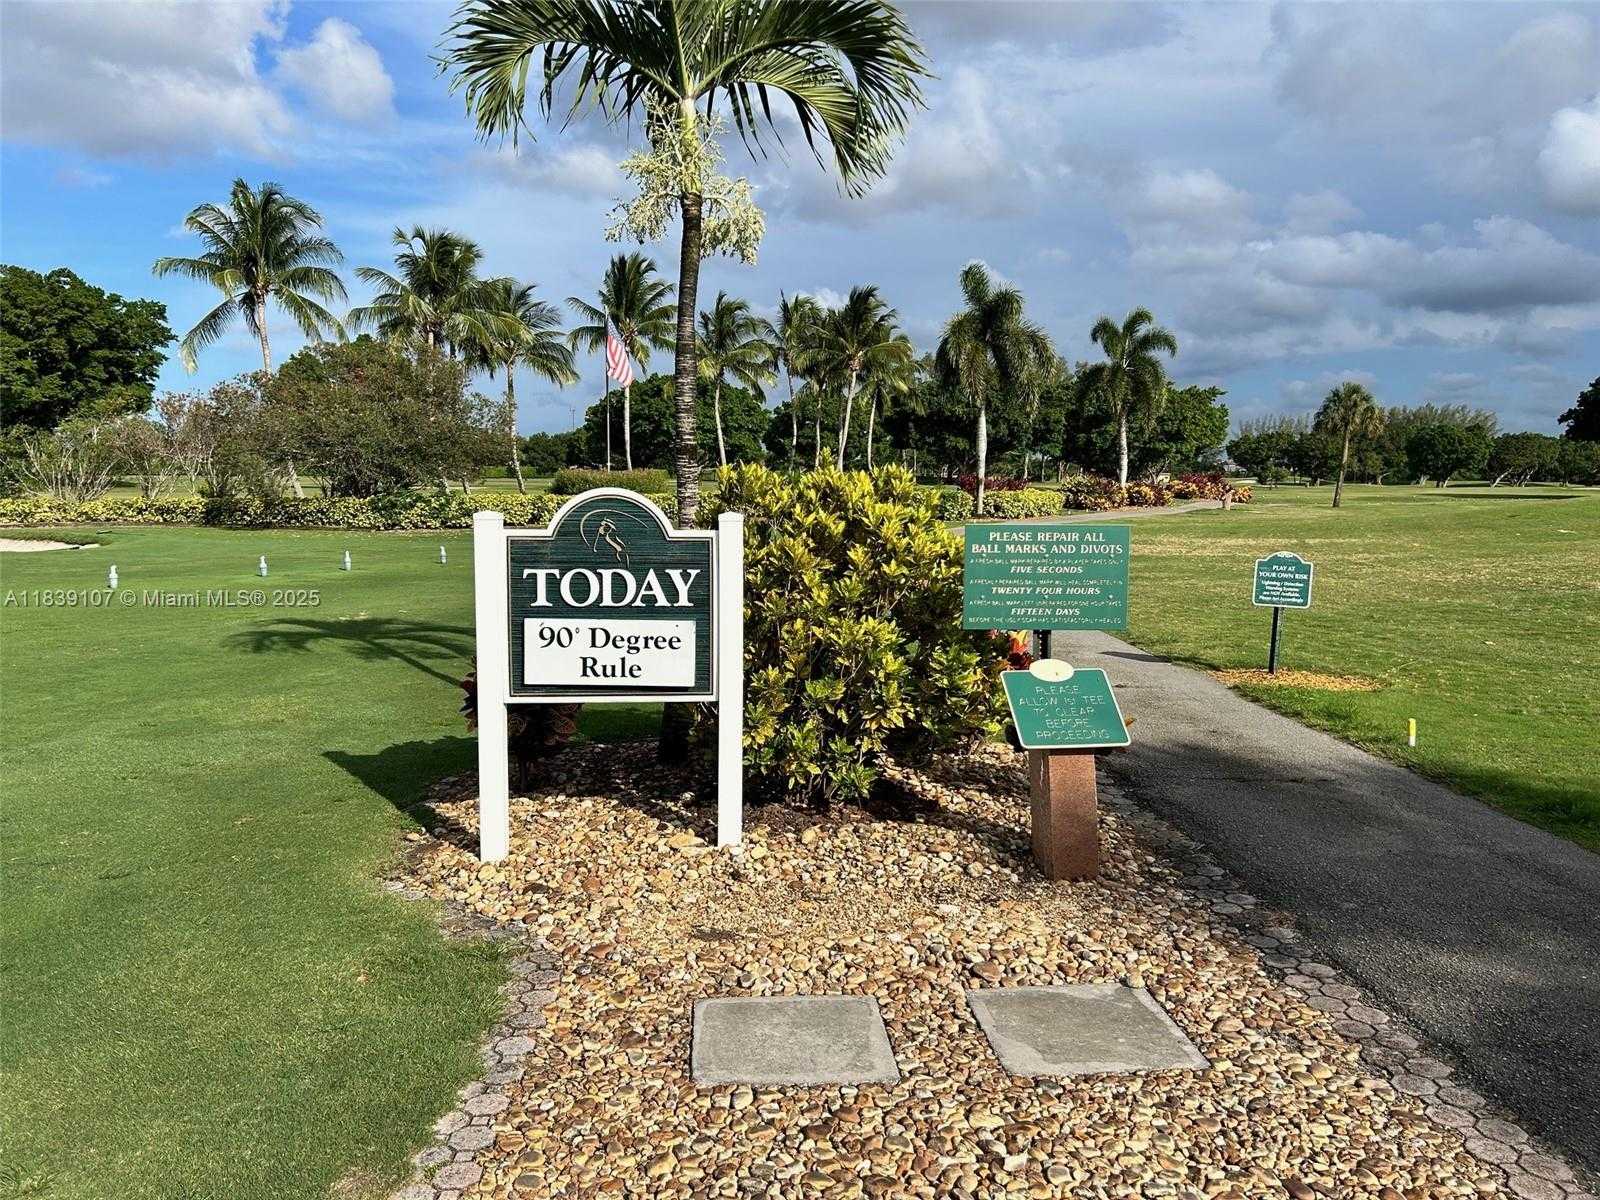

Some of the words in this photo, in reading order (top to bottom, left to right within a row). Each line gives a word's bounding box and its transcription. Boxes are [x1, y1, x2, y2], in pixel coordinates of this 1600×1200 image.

[990, 532, 1032, 541] PLEASE
[1038, 532, 1079, 542] REPAIR
[1084, 532, 1105, 542] ALL
[972, 544, 1000, 553] BALL
[1005, 544, 1046, 554] MARKS
[1050, 544, 1076, 553] AND
[1080, 544, 1122, 554] DIVOTS
[522, 568, 701, 607] TODAY
[539, 626, 580, 648] 90°
[588, 628, 681, 654] Degree
[580, 656, 642, 678] Rule
[1036, 686, 1081, 695] PLEASE
[1019, 697, 1058, 706] ALLOW
[1082, 695, 1106, 704] TEE
[1034, 708, 1048, 717] TO
[1055, 707, 1095, 717] CLEAR
[1046, 719, 1090, 728] BEFORE
[1036, 729, 1110, 740] PROCEEDING
